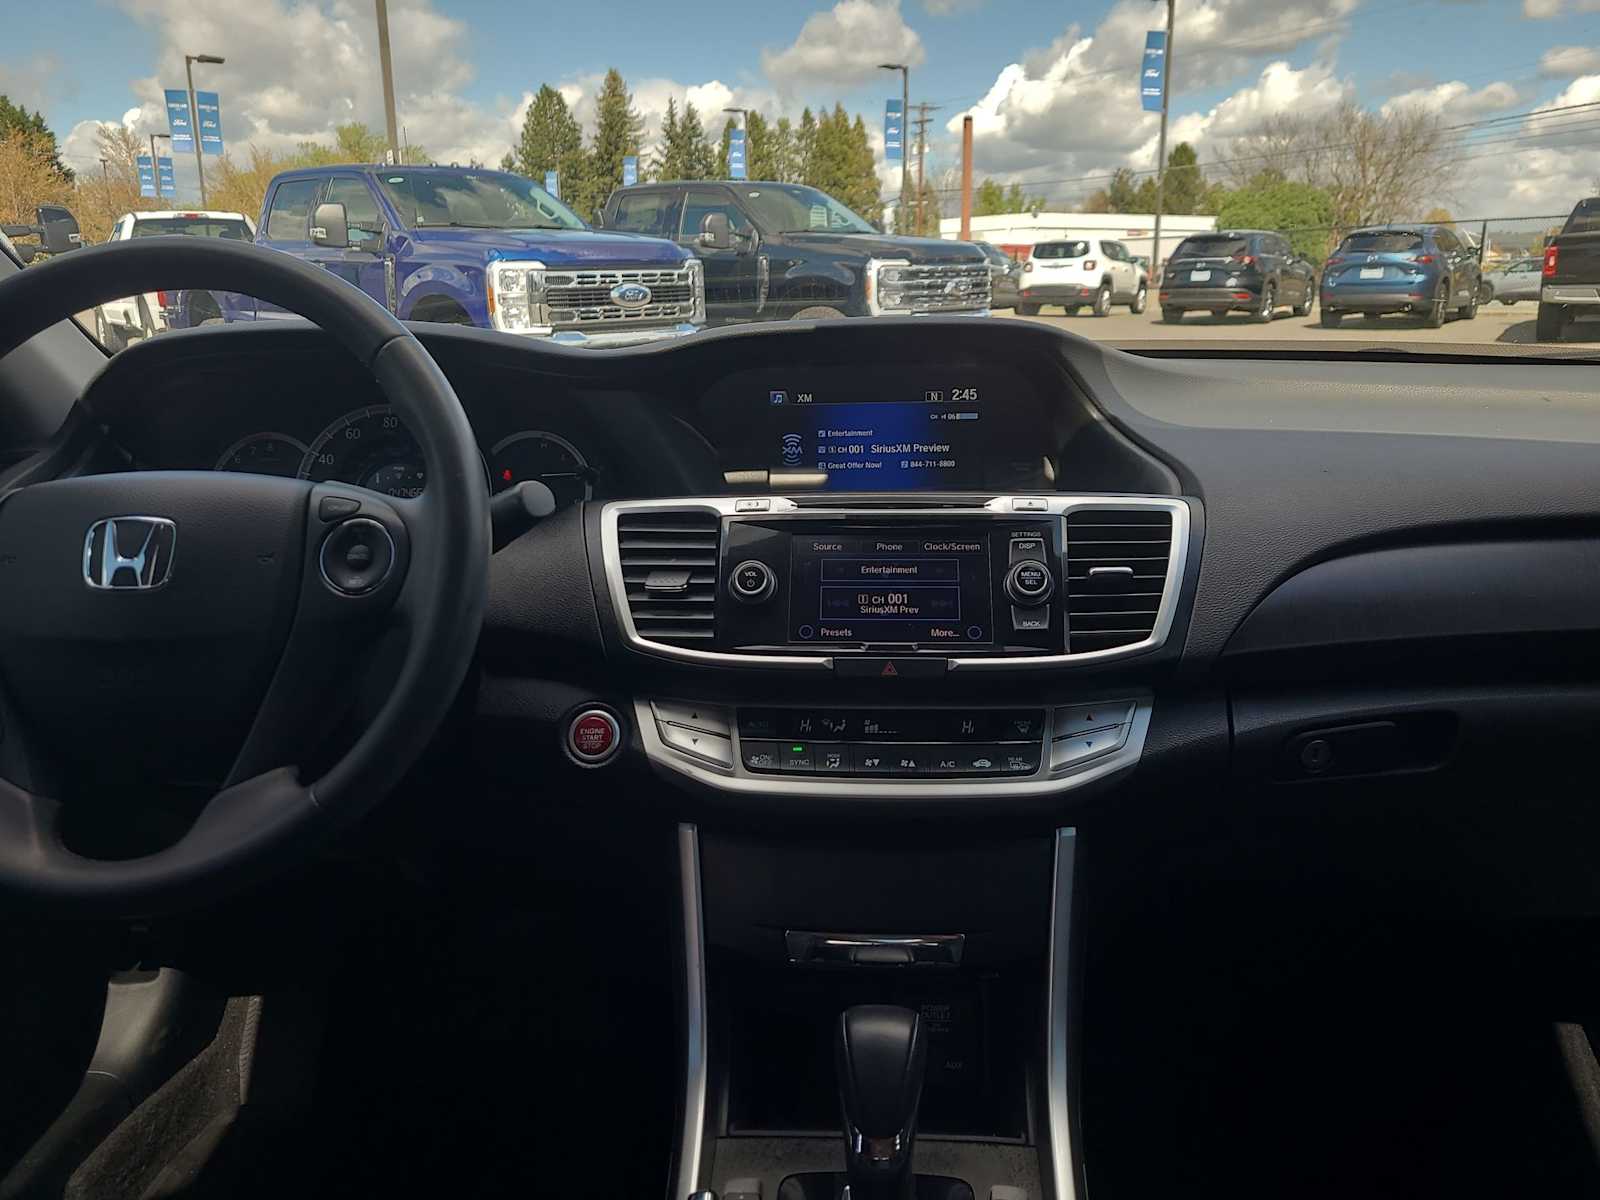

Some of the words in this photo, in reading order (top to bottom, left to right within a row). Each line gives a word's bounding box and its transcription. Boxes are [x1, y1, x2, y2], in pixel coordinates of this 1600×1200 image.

[797, 393, 813, 403] XM
[951, 388, 978, 401] 2:45
[345, 428, 361, 439] 60
[828, 430, 873, 438] Entertainment
[848, 444, 865, 454] 001
[871, 443, 911, 454] SiriusXM
[913, 443, 950, 453] Preview
[318, 454, 335, 464] 40
[813, 543, 843, 551] Source
[876, 542, 903, 551] Phone
[924, 542, 981, 552] Clock/Screen
[1018, 542, 1036, 550] DISP
[860, 565, 918, 575] Entertainment
[872, 595, 885, 604] CH
[887, 593, 909, 605] 001
[860, 605, 898, 615] SiriusXM
[900, 606, 920, 616] Prev
[820, 628, 853, 638] Presets
[580, 727, 606, 735] ENGINE
[940, 760, 956, 768] A/C
